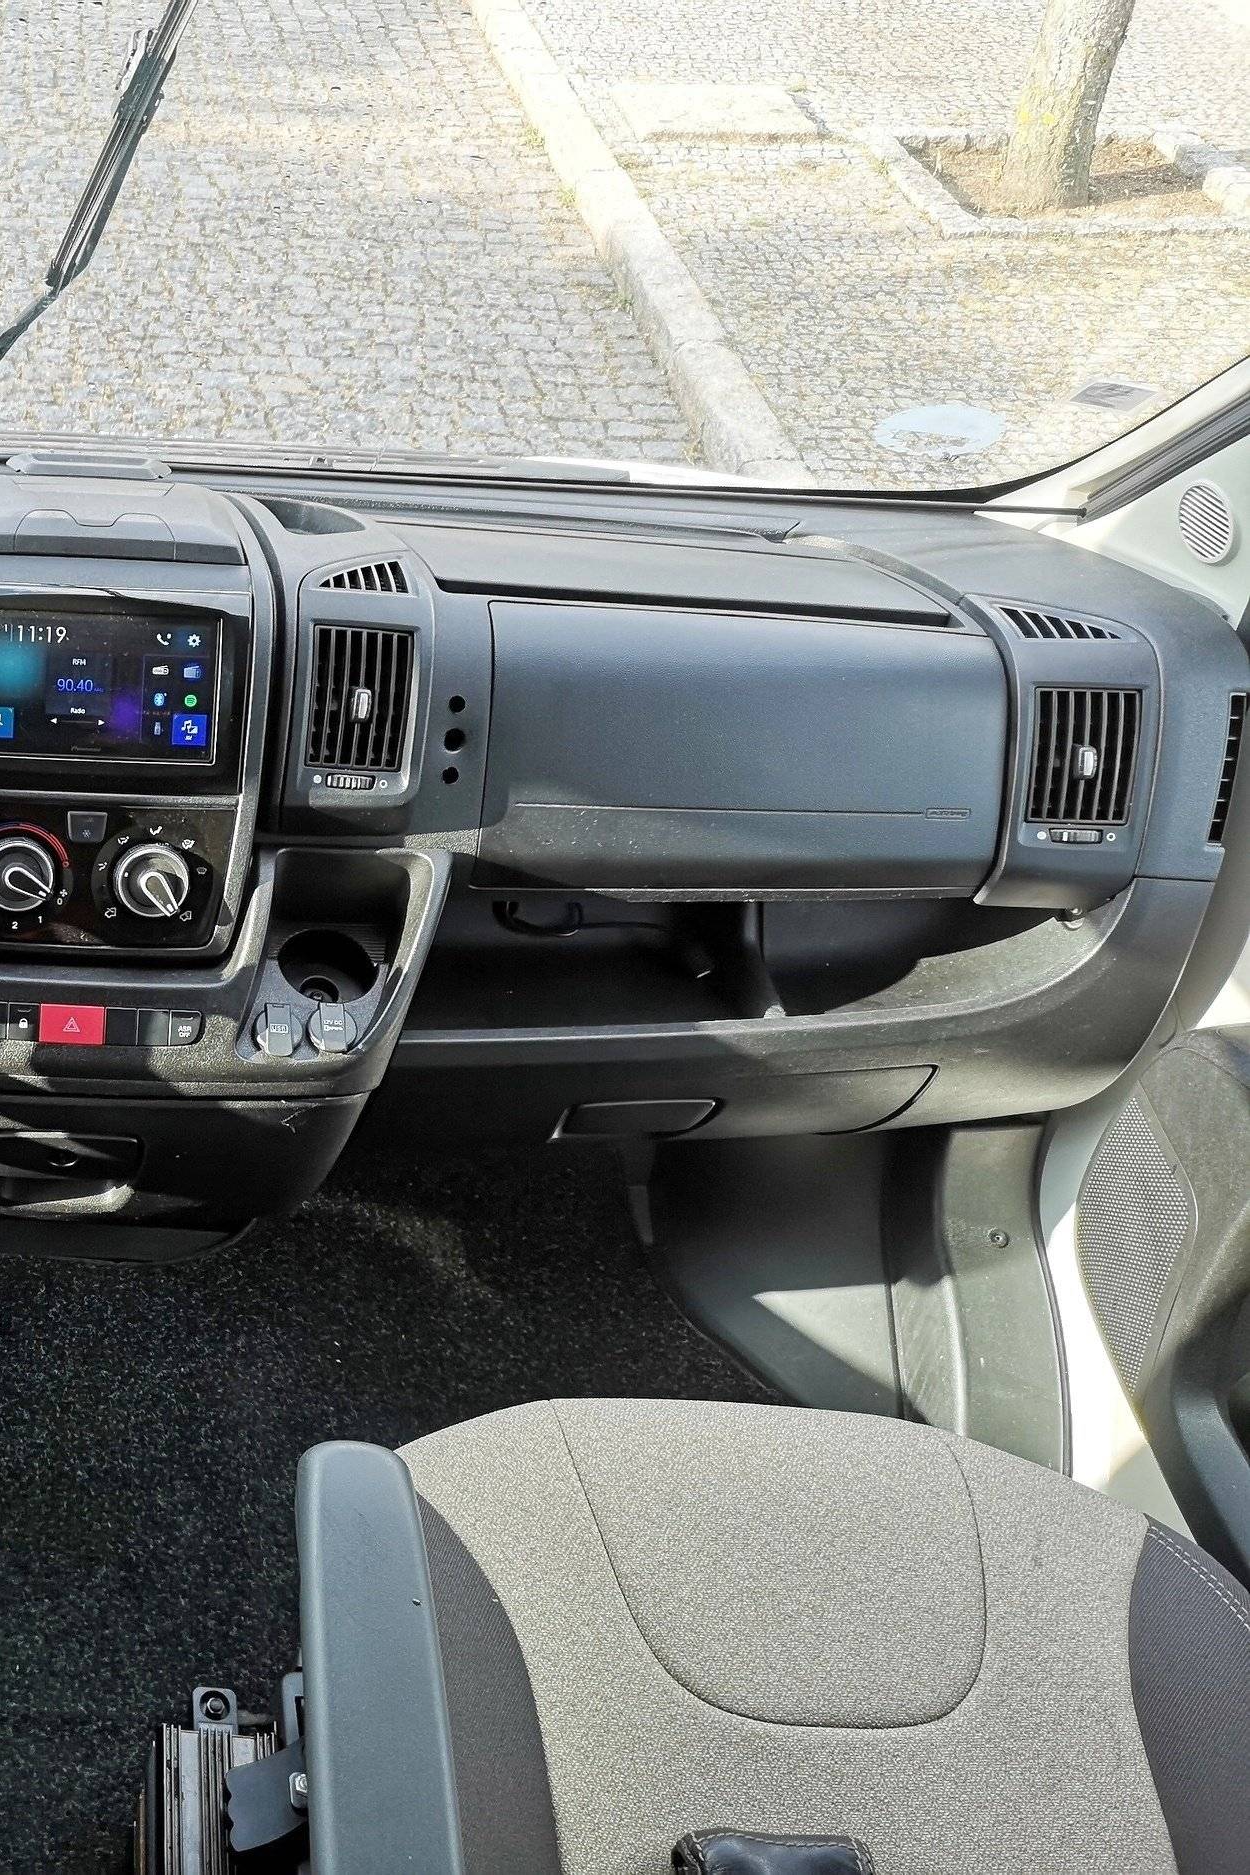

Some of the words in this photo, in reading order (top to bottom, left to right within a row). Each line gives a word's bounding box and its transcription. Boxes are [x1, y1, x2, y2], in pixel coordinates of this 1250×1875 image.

[17, 625, 67, 643] 11:19
[72, 658, 87, 666] RFM
[57, 678, 93, 692] 90.40
[70, 707, 86, 715] Radio
[57, 897, 63, 906] 0
[37, 915, 43, 924] 1
[11, 921, 19, 930] 2
[270, 1024, 288, 1033] USB
